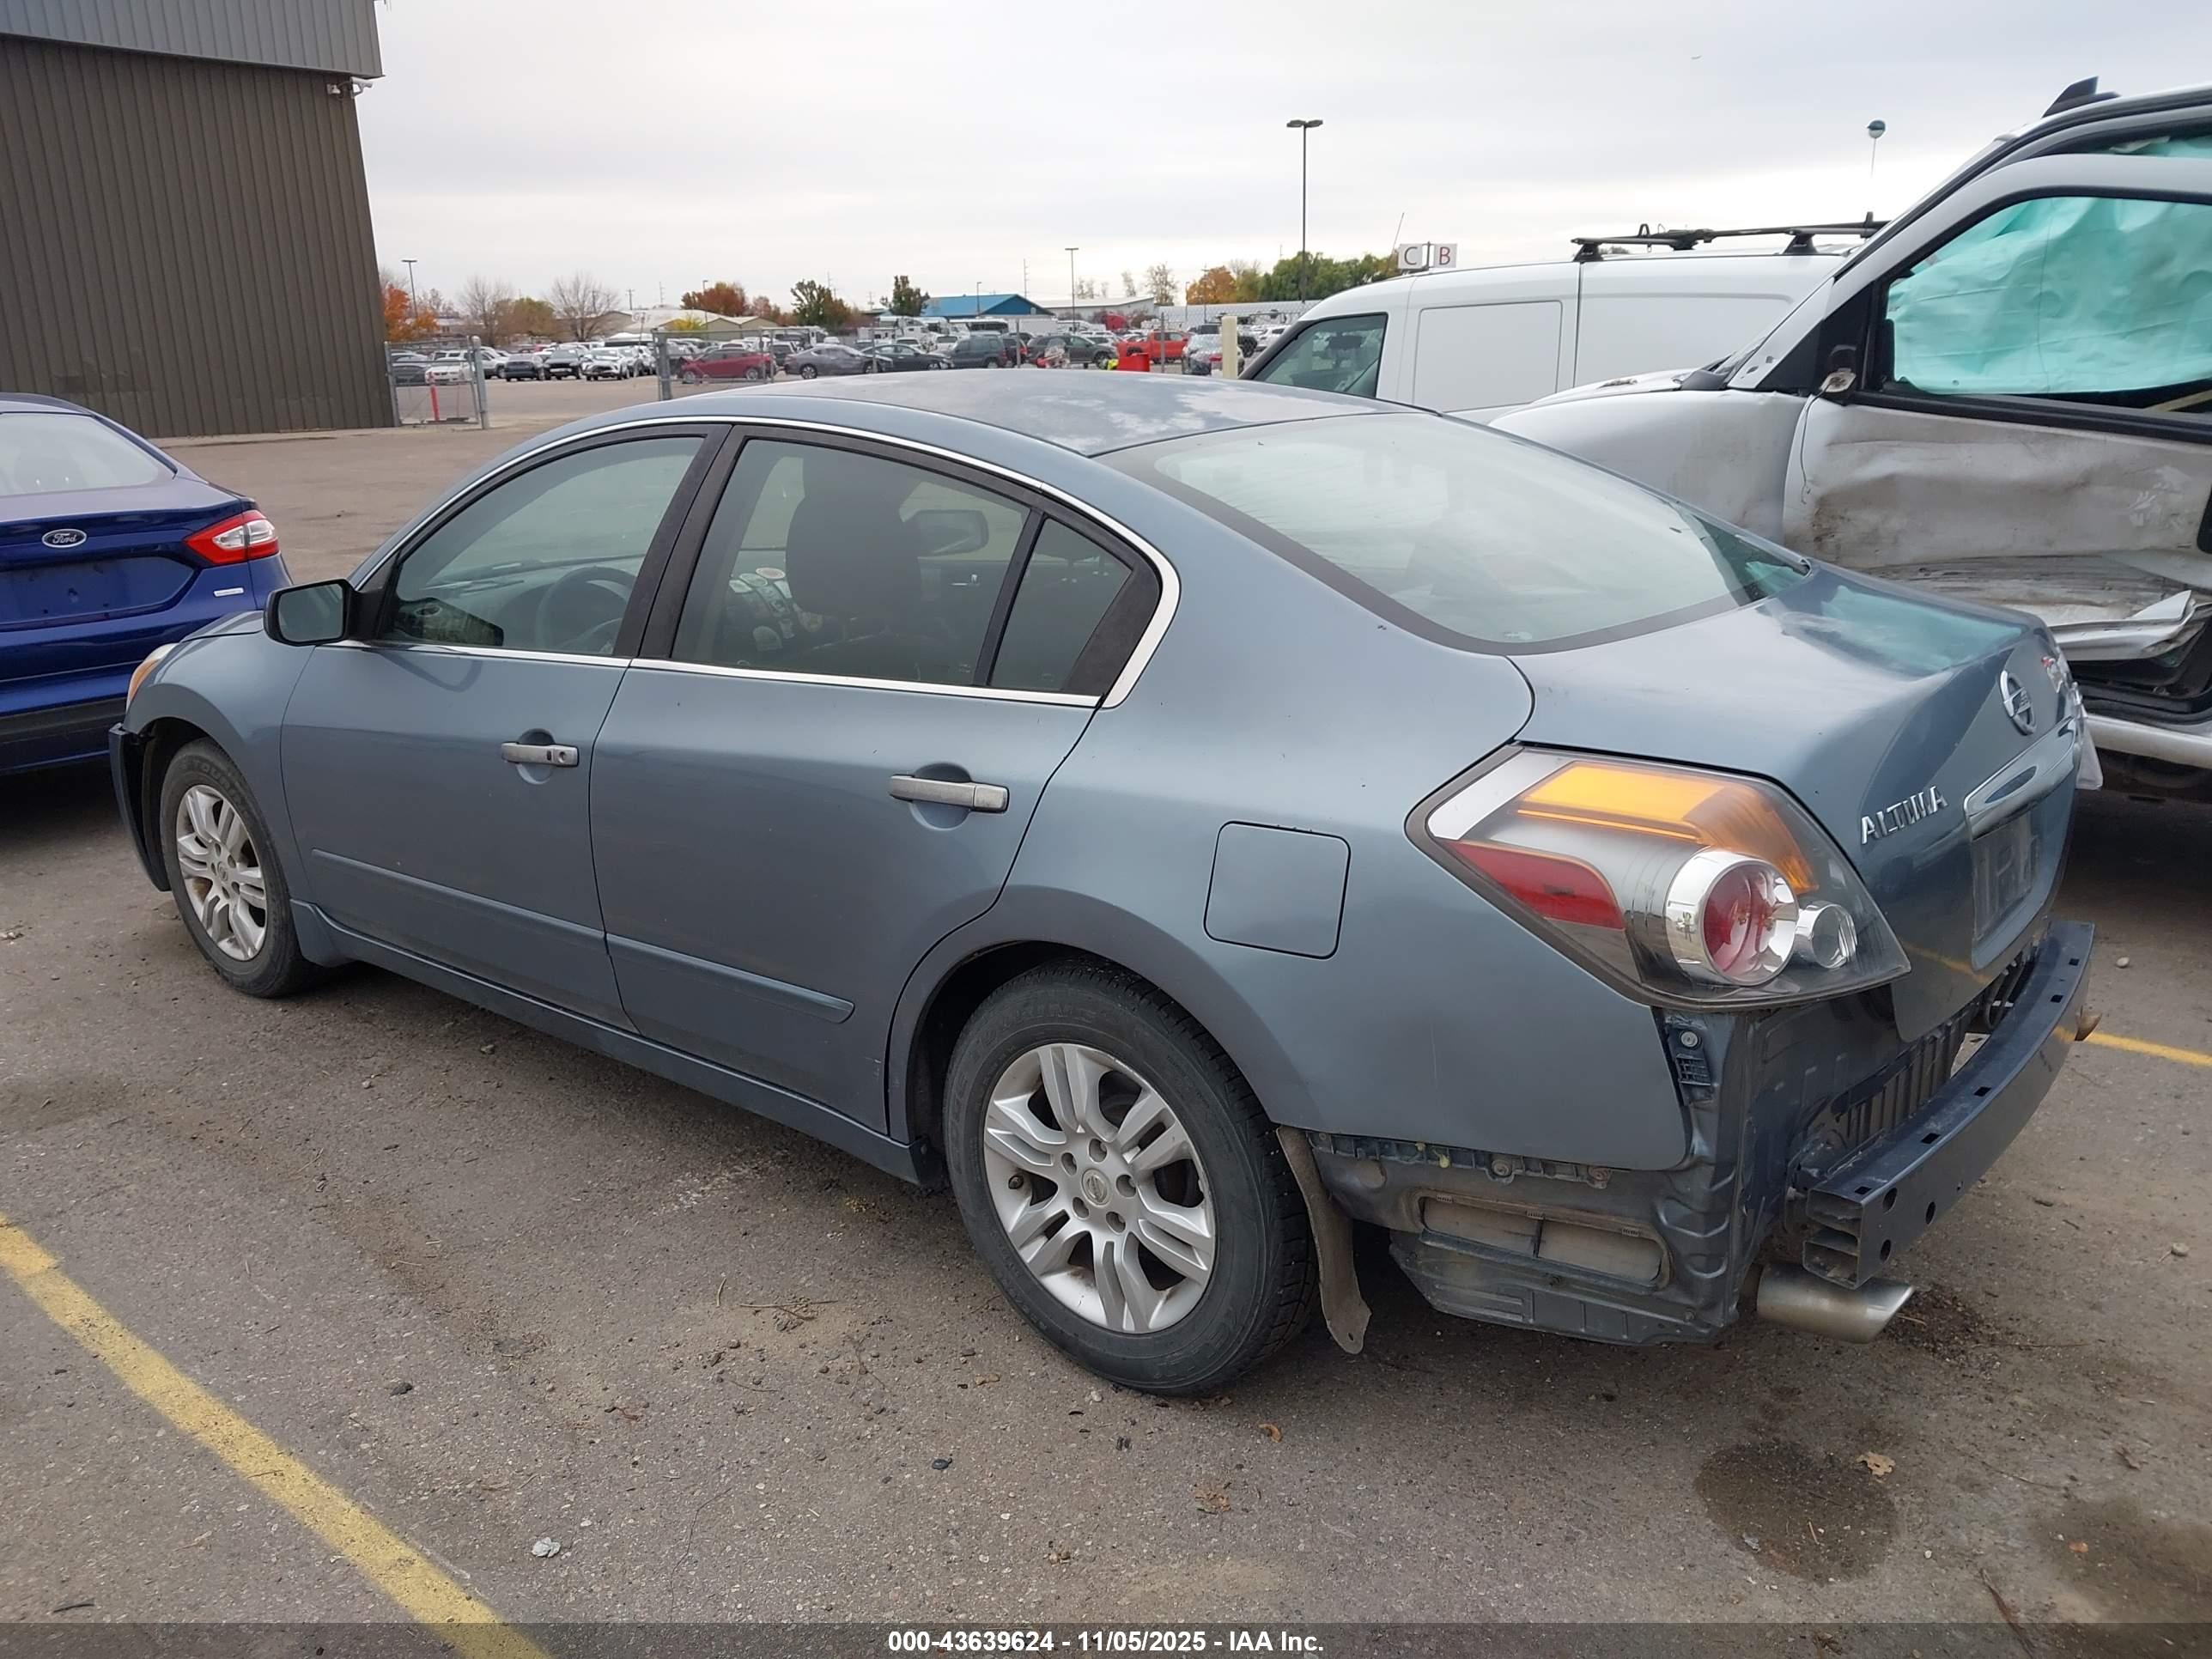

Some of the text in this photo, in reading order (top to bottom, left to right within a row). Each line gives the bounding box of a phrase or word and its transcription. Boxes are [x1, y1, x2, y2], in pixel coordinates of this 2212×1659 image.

[1404, 246, 1418, 265] C
[1438, 246, 1450, 265] B
[1861, 785, 1948, 845] ALTIMA
